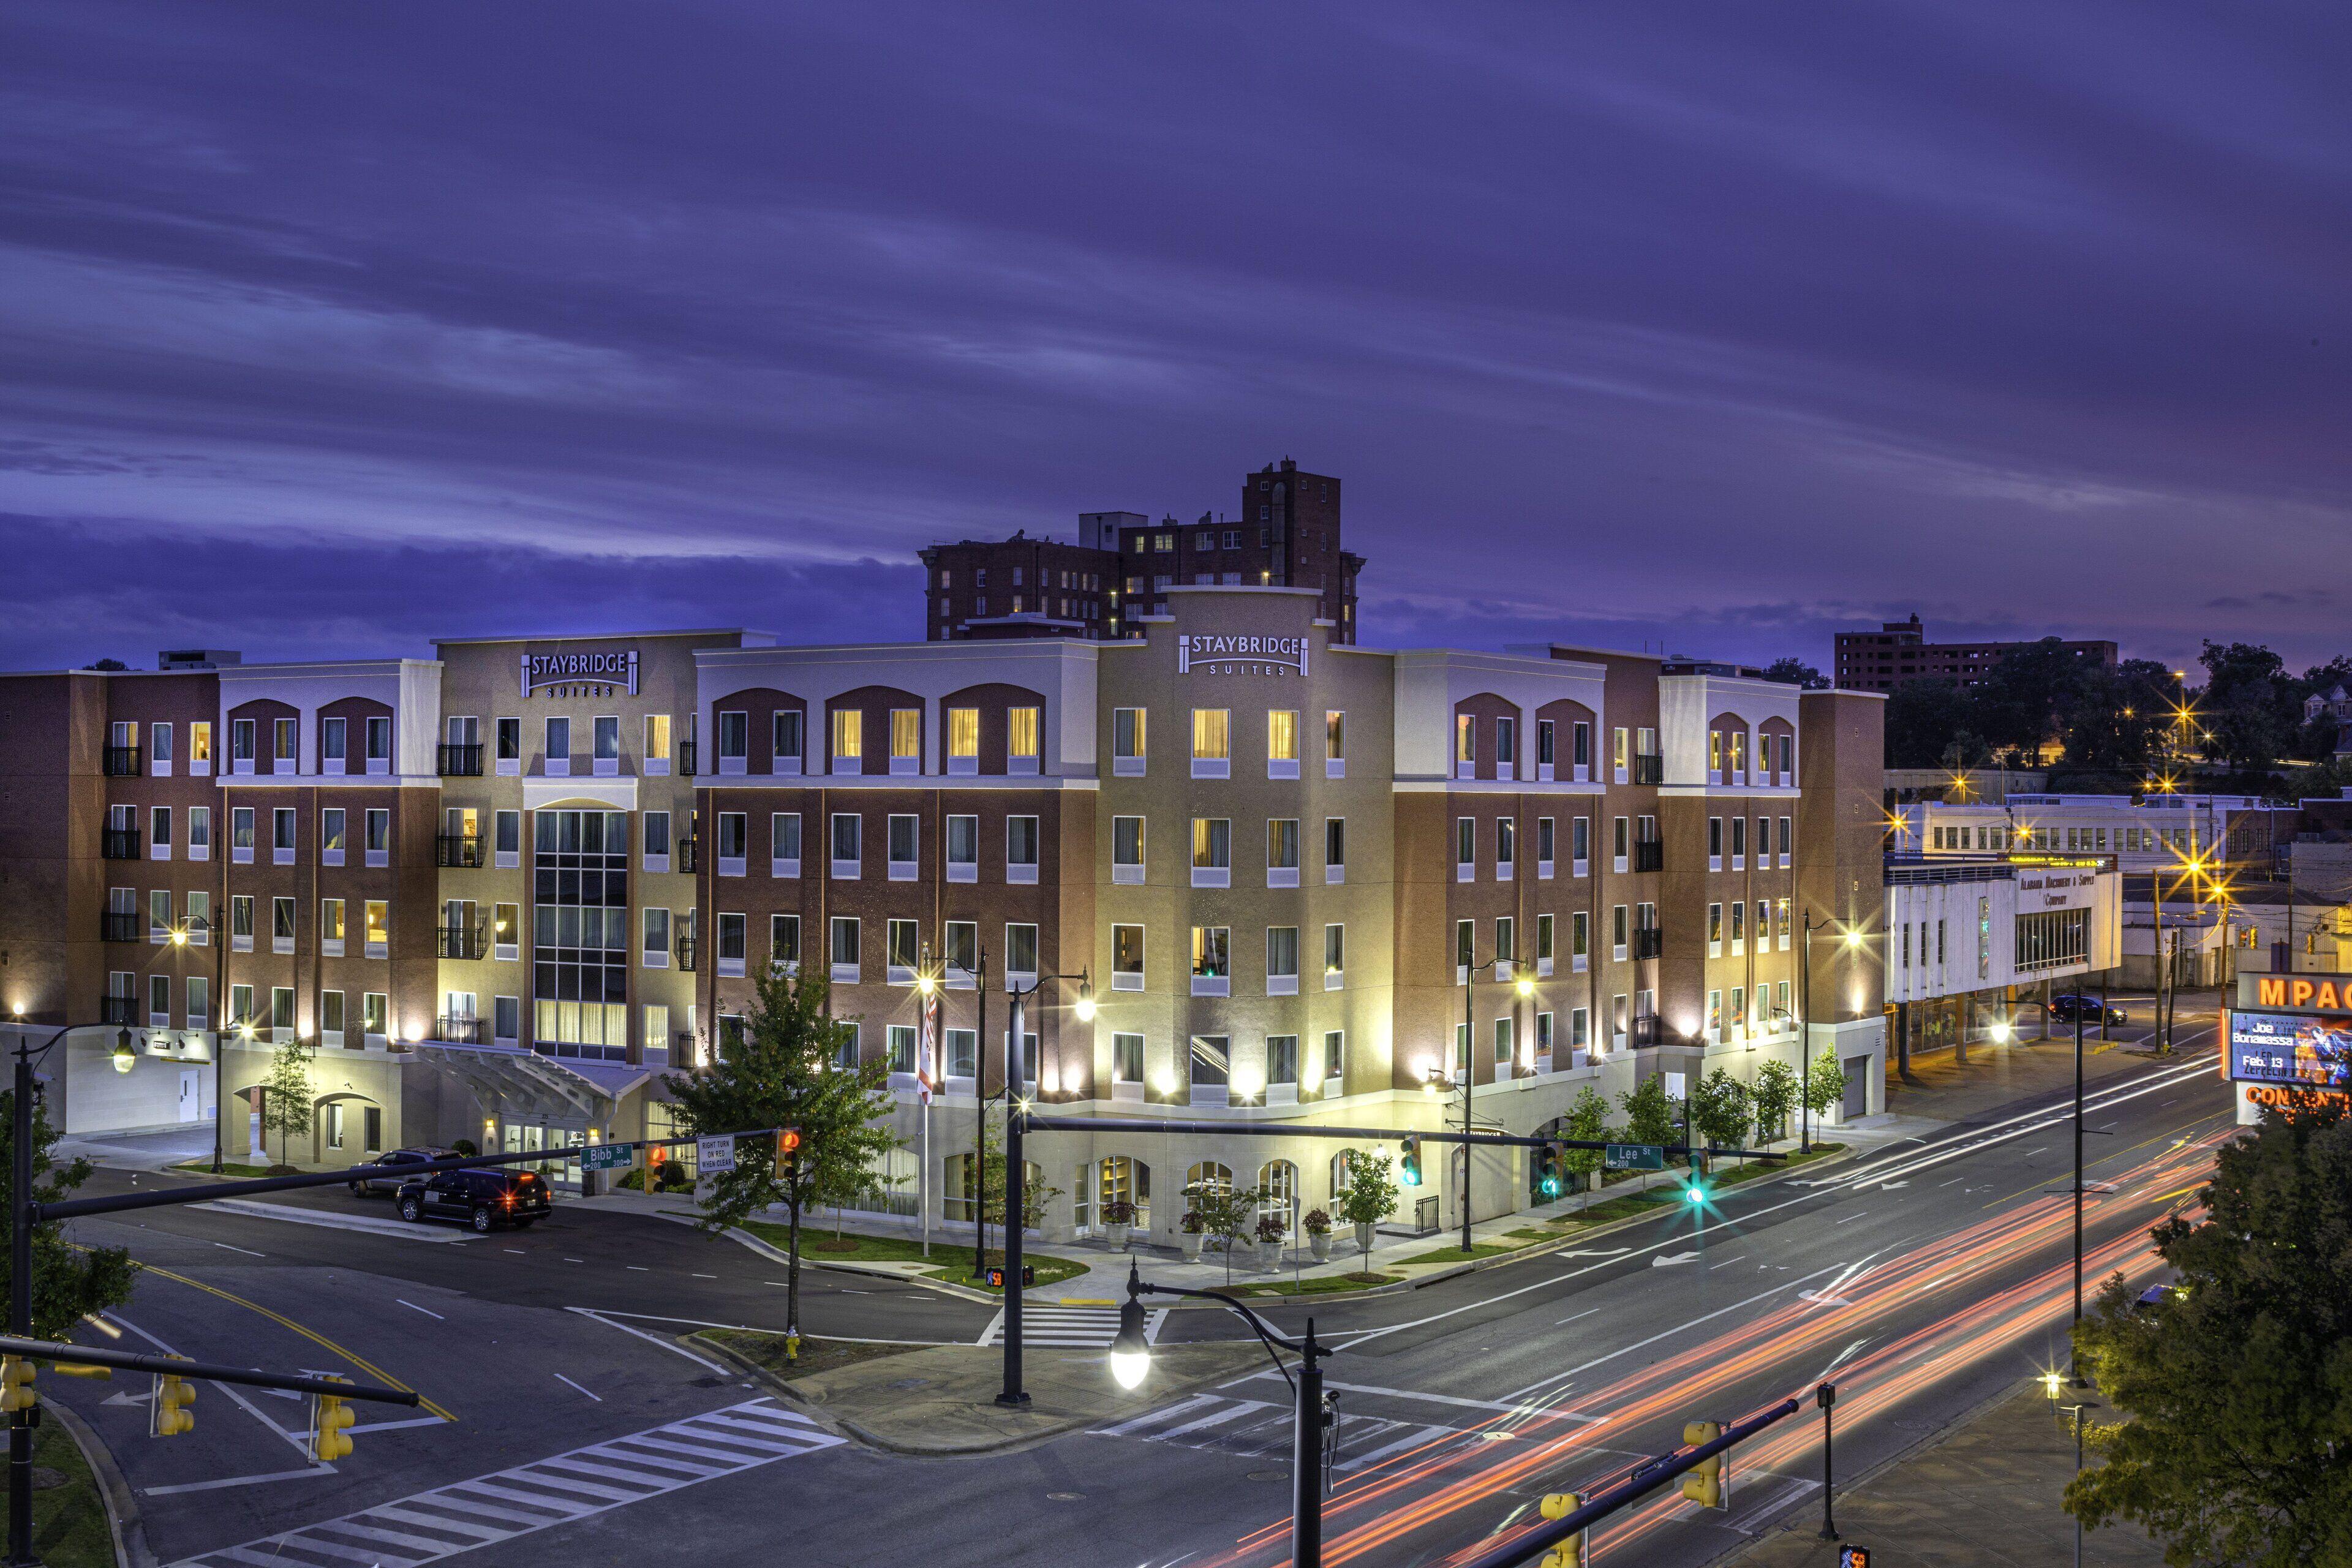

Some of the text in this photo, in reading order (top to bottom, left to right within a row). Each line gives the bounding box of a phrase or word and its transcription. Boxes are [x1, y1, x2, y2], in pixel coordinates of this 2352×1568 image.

[1192, 636, 1299, 655] STAYBRIDGE
[532, 654, 626, 674] STAYBRIDGE
[1210, 665, 1284, 676] SUITES
[546, 686, 611, 698] SUITES
[2020, 877, 2043, 891] ALABAMA
[2079, 873, 2095, 886] SUPPLY
[2045, 893, 2067, 907] COMPANY
[2252, 1022, 2274, 1034] Joe
[2242, 1055, 2283, 1068] Feb. 13
[702, 1141, 715, 1150] RIGHT
[590, 1148, 612, 1161] Bibb
[1619, 1147, 1638, 1159] Lee
